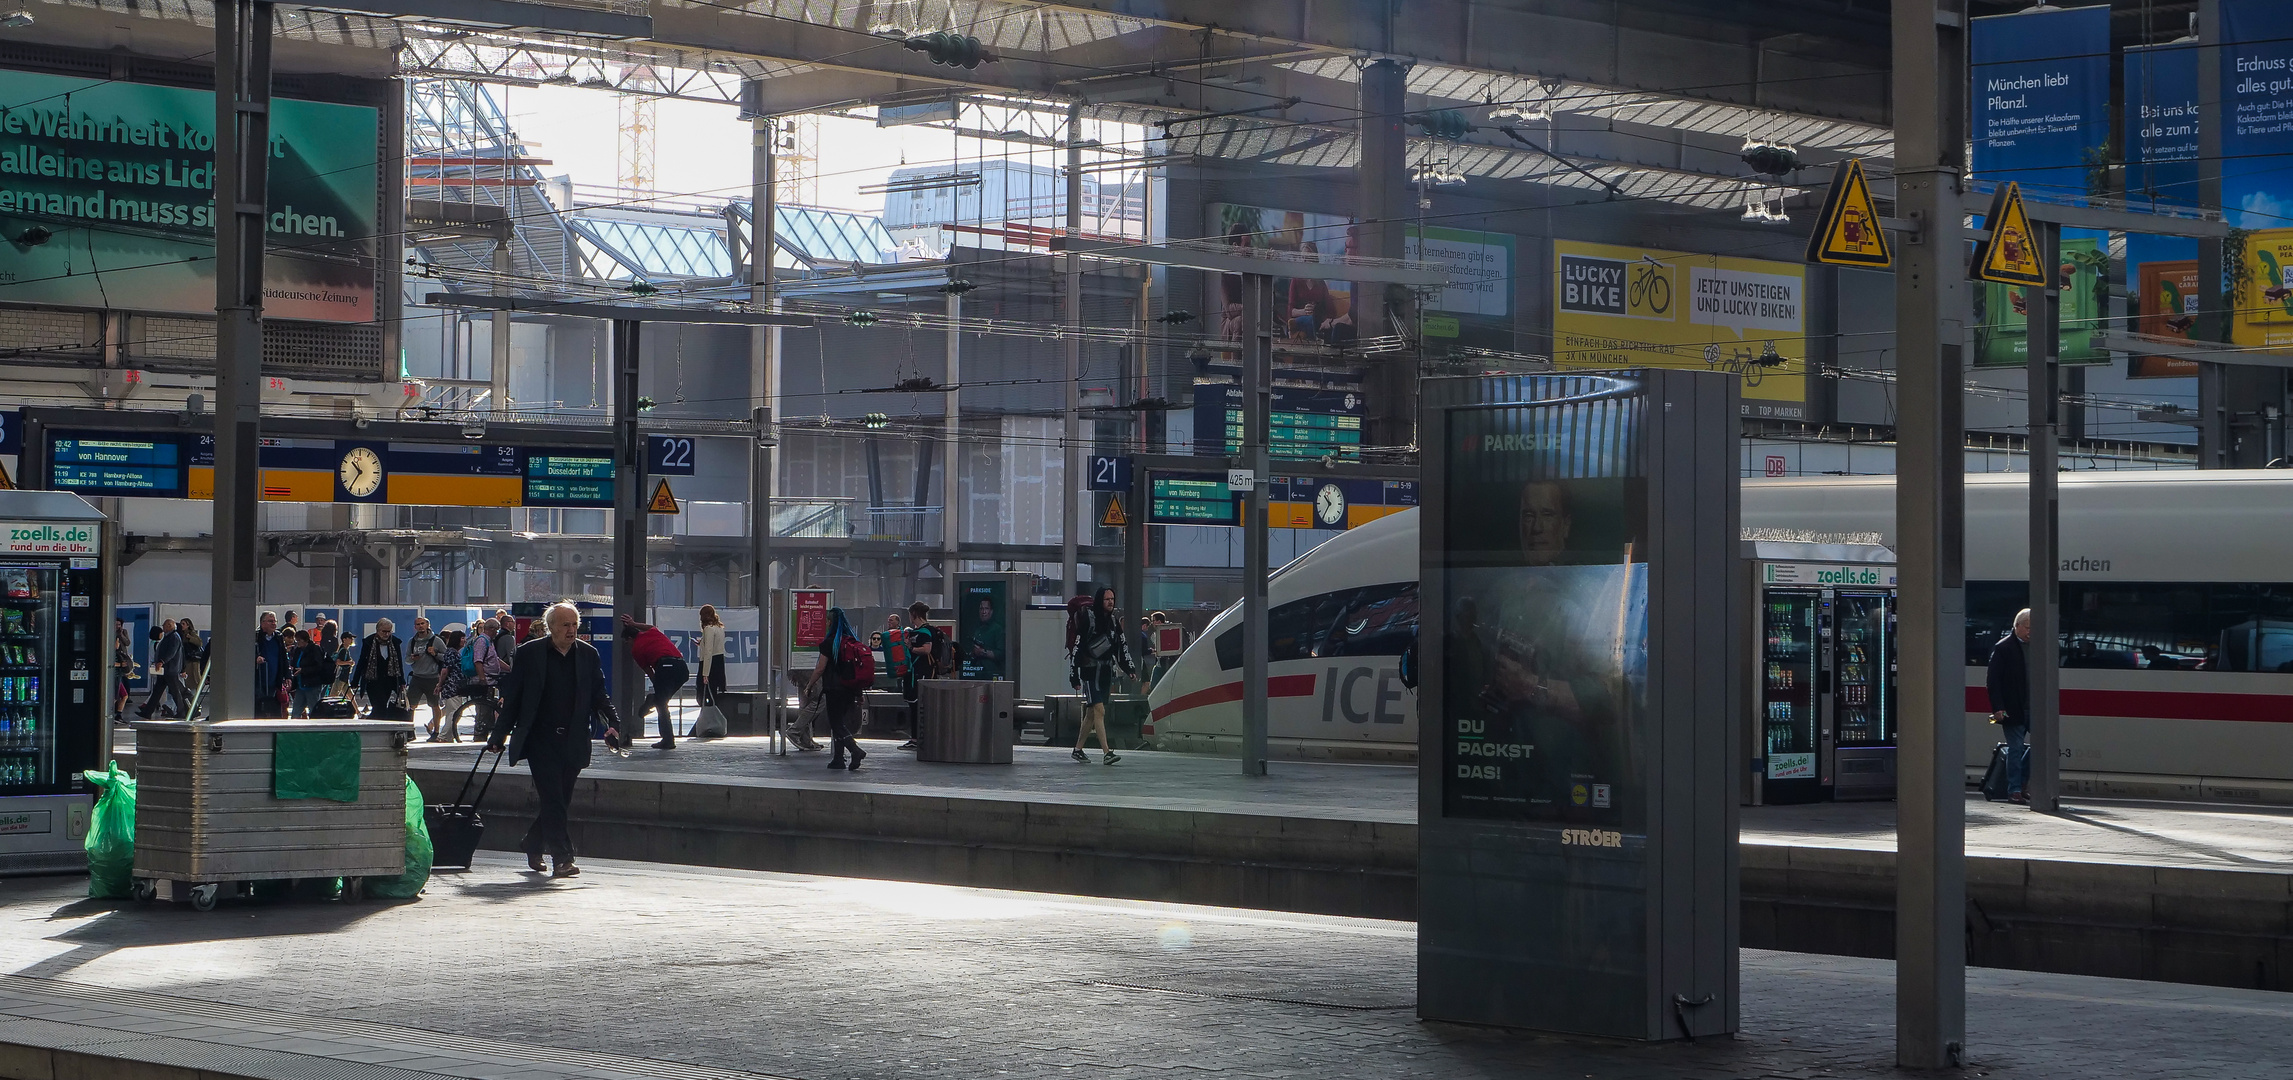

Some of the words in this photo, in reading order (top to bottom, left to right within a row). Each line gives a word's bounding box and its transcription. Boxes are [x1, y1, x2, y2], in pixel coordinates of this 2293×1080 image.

[2237, 55, 2286, 72] Erdnuss
[1987, 75, 2041, 92] München
[2044, 72, 2070, 87] liebt
[2237, 77, 2266, 93] alles
[1988, 94, 2028, 110] Pflanzl.
[2141, 105, 2160, 118] Bei
[2163, 107, 2184, 117] uns
[2187, 101, 2199, 115] ko
[2237, 102, 2255, 112] Auch
[2272, 100, 2285, 109] Die
[1988, 119, 1999, 127] Die
[2000, 116, 2020, 126] Hälfte
[2020, 117, 2044, 125] unserer
[2045, 112, 2081, 123] Kakaofarm
[2237, 113, 2277, 124] Kakaofarm
[28, 109, 170, 148] Wahrheit
[177, 121, 285, 159] kot
[1988, 128, 2006, 138] bleibt
[2064, 123, 2078, 132] und
[2141, 123, 2162, 138] alle
[2166, 125, 2191, 136] zum
[2237, 126, 2247, 135] für
[2248, 125, 2266, 134] Tiere
[2267, 123, 2281, 133] und
[2177, 143, 2189, 152] auf
[0, 144, 104, 181] alleine
[107, 160, 161, 185] ans
[165, 158, 216, 190] Lich
[109, 198, 189, 226] muss
[192, 200, 216, 229] si
[1413, 245, 1466, 259] Unternehmen
[1485, 255, 1494, 263] es
[1566, 264, 1622, 285] LUCKY
[1475, 281, 1494, 293] wird
[1566, 282, 1620, 308] BIKE
[1697, 278, 1728, 296] JETZT
[1730, 281, 1791, 301] UMSTEIGEN
[321, 290, 359, 307] Zeitung
[1697, 296, 1720, 313] UND
[1723, 299, 1758, 317] LUCKY
[1760, 302, 1796, 320] BIKEN!
[1565, 336, 1600, 349] EINFACH
[1602, 339, 1618, 350] DAS
[1578, 352, 1587, 361] IN
[1589, 352, 1629, 364] MÜNCHEN
[1759, 405, 1772, 416] TOP
[1774, 406, 1802, 418] MARKEN
[54, 440, 72, 448] 10:42
[200, 435, 215, 445] 24-
[1484, 433, 1562, 452] PARKSIDE
[94, 452, 128, 461] Hannover
[498, 446, 514, 456] 5-21
[662, 438, 691, 467] 22
[548, 467, 581, 475] Düsseldorf
[582, 468, 594, 476] Hbf
[1096, 457, 1117, 483] 21
[1768, 459, 1783, 475] DB
[1229, 474, 1244, 486] 425
[1245, 477, 1253, 486] m
[1178, 490, 1200, 499] Nürnberg
[10, 525, 88, 541] zoells.de
[10, 542, 33, 551] rund
[35, 543, 50, 551] um
[52, 543, 67, 552] die
[69, 543, 87, 552] Uhr
[2058, 555, 2111, 572] achen
[1817, 566, 1877, 584] zoells.de
[1321, 666, 1406, 725] ICE
[1458, 719, 1485, 734] DU
[1458, 741, 1535, 759] PACKST
[1774, 755, 1807, 771] zoells.de
[1458, 764, 1501, 781] DAS!
[1561, 828, 1622, 848] STRÖER
